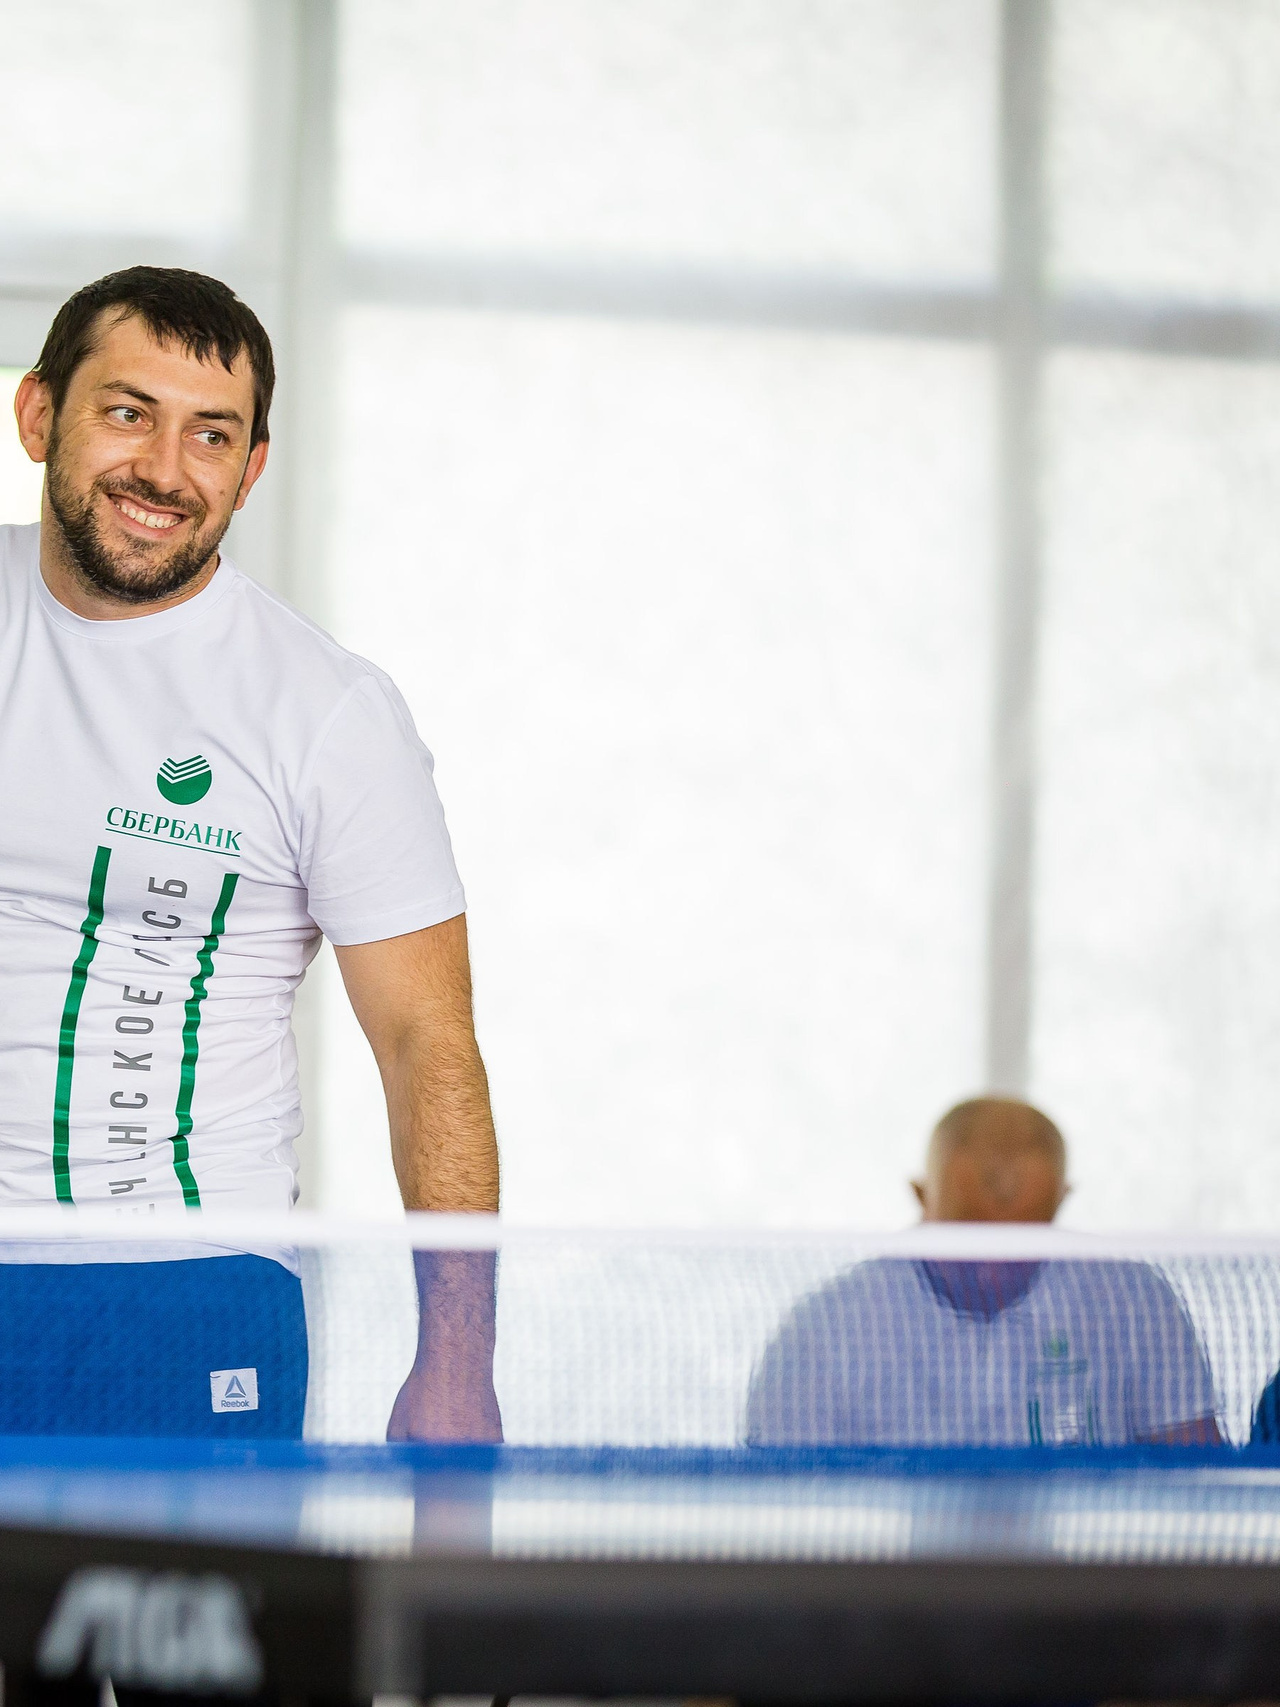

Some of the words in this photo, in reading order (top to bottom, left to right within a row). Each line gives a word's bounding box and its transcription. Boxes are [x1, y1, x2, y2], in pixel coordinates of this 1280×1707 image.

[106, 806, 242, 851] СБЕРБАНК
[108, 984, 163, 1216] ЧНСКОЕ
[220, 1400, 250, 1408] Reebok
